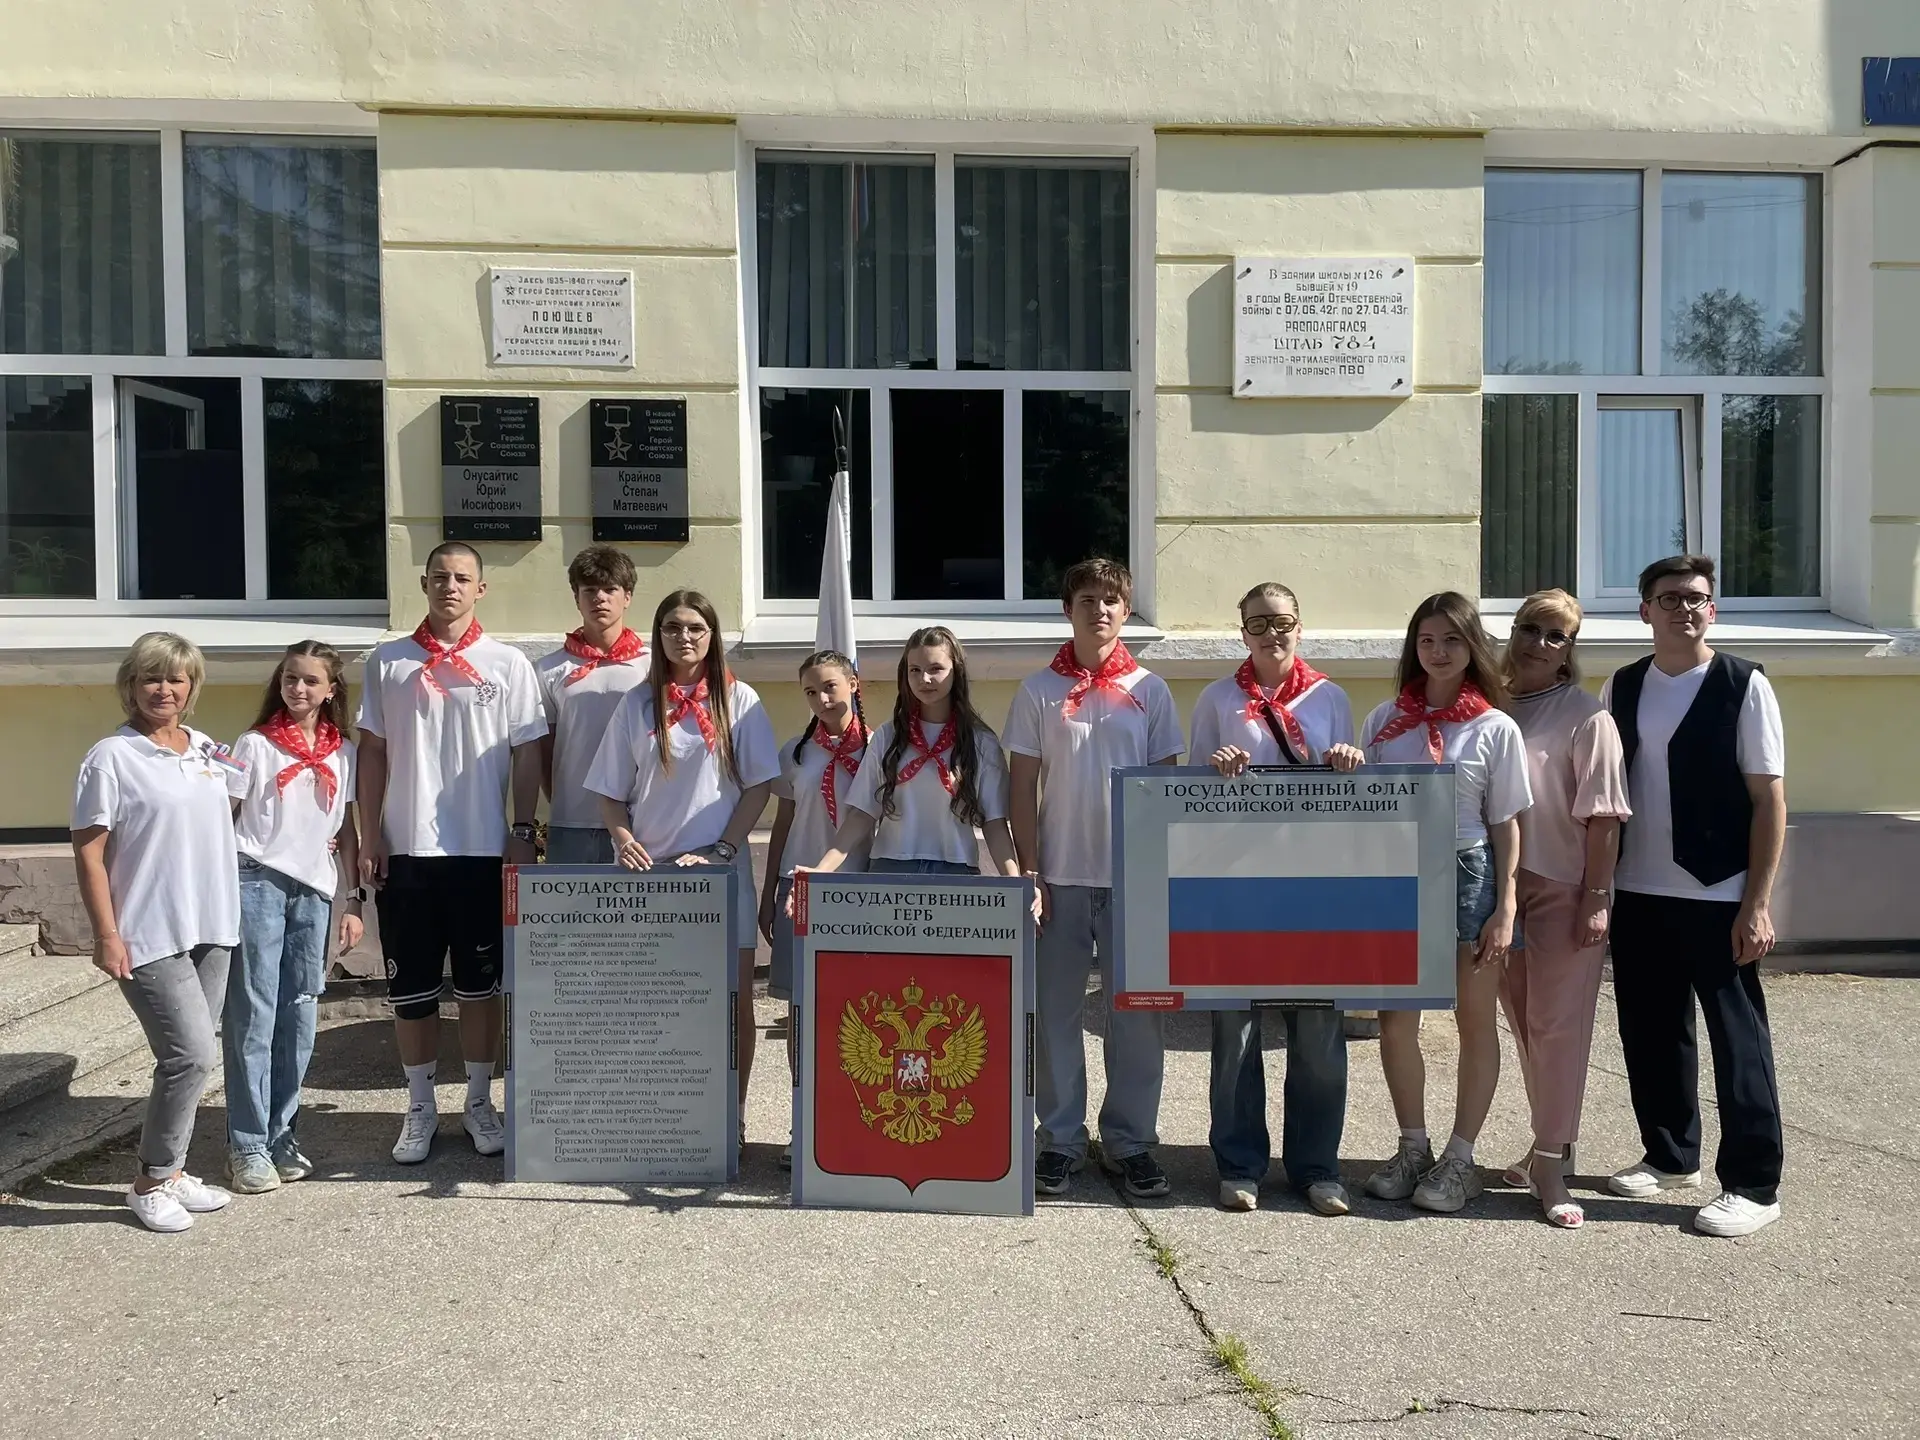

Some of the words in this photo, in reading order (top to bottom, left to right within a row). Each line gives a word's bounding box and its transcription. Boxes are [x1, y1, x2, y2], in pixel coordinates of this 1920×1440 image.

[1269, 269, 1277, 280] В
[1364, 270, 1383, 280] 126
[1347, 282, 1358, 291] 19
[533, 311, 593, 322] ПОЮЩЕВ
[1285, 321, 1367, 333] РАСПОЛАГАЛСЯ
[1274, 338, 1323, 350] ШТАБ
[1332, 336, 1376, 350] 784
[1339, 366, 1365, 375] ПВО
[500, 434, 524, 442] Герой
[649, 437, 673, 445] Герой
[490, 442, 535, 450] Советского
[639, 444, 683, 452] Советского
[648, 452, 674, 460] Союза
[463, 469, 519, 484] Онусайтис
[618, 471, 662, 485] Крайнов
[476, 483, 506, 497] Юрий
[622, 484, 658, 498] Степан
[461, 498, 522, 512] Иосифович
[613, 500, 668, 512] Матвеевич
[474, 522, 510, 530] СТРЕЛОК
[1164, 780, 1356, 798] ГОСУДАРСТВЕННЫЙ
[1367, 782, 1420, 796] ФЛАГ
[1184, 798, 1294, 813] РОССИЙСКОЙ
[1301, 800, 1398, 813] ФЕДЕРАЦИИ
[532, 878, 712, 899] ГОСУДАРСТВЕННЫЙ
[596, 896, 647, 909] ГИМН
[821, 891, 1006, 908] ГОСУДАРСТВЕННЫЙ
[522, 911, 625, 925] РОССИЙСКОЙ
[631, 912, 721, 926] ФЕДЕРАЦИИ
[894, 909, 933, 921] ГЕРБ
[811, 922, 917, 937] РОССИЙСКОЙ
[923, 927, 1017, 941] ФЕДЕРАЦИИ
